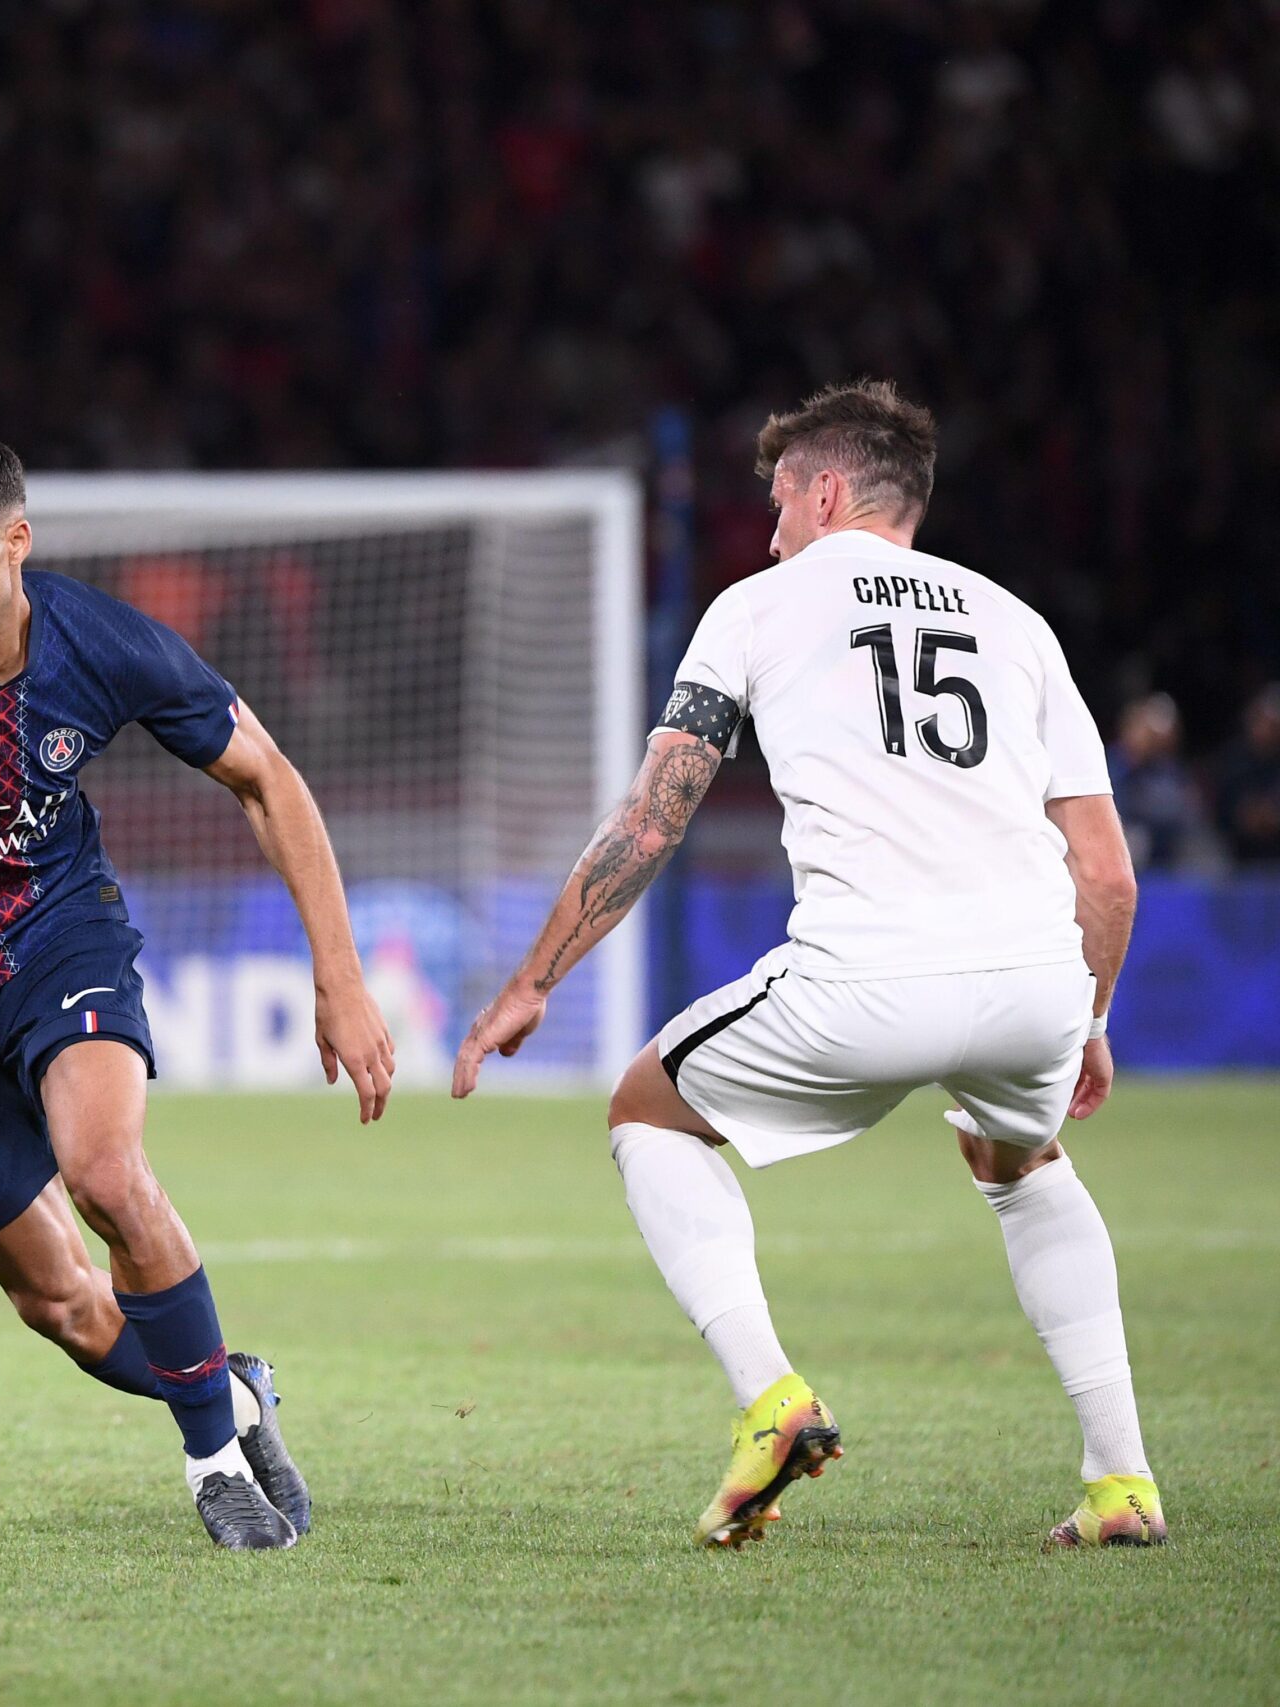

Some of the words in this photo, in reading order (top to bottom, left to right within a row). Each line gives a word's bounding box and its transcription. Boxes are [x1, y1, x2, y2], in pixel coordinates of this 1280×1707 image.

[853, 576, 969, 615] CAPELLE
[850, 623, 988, 769] 15
[47, 730, 77, 741] PARIS
